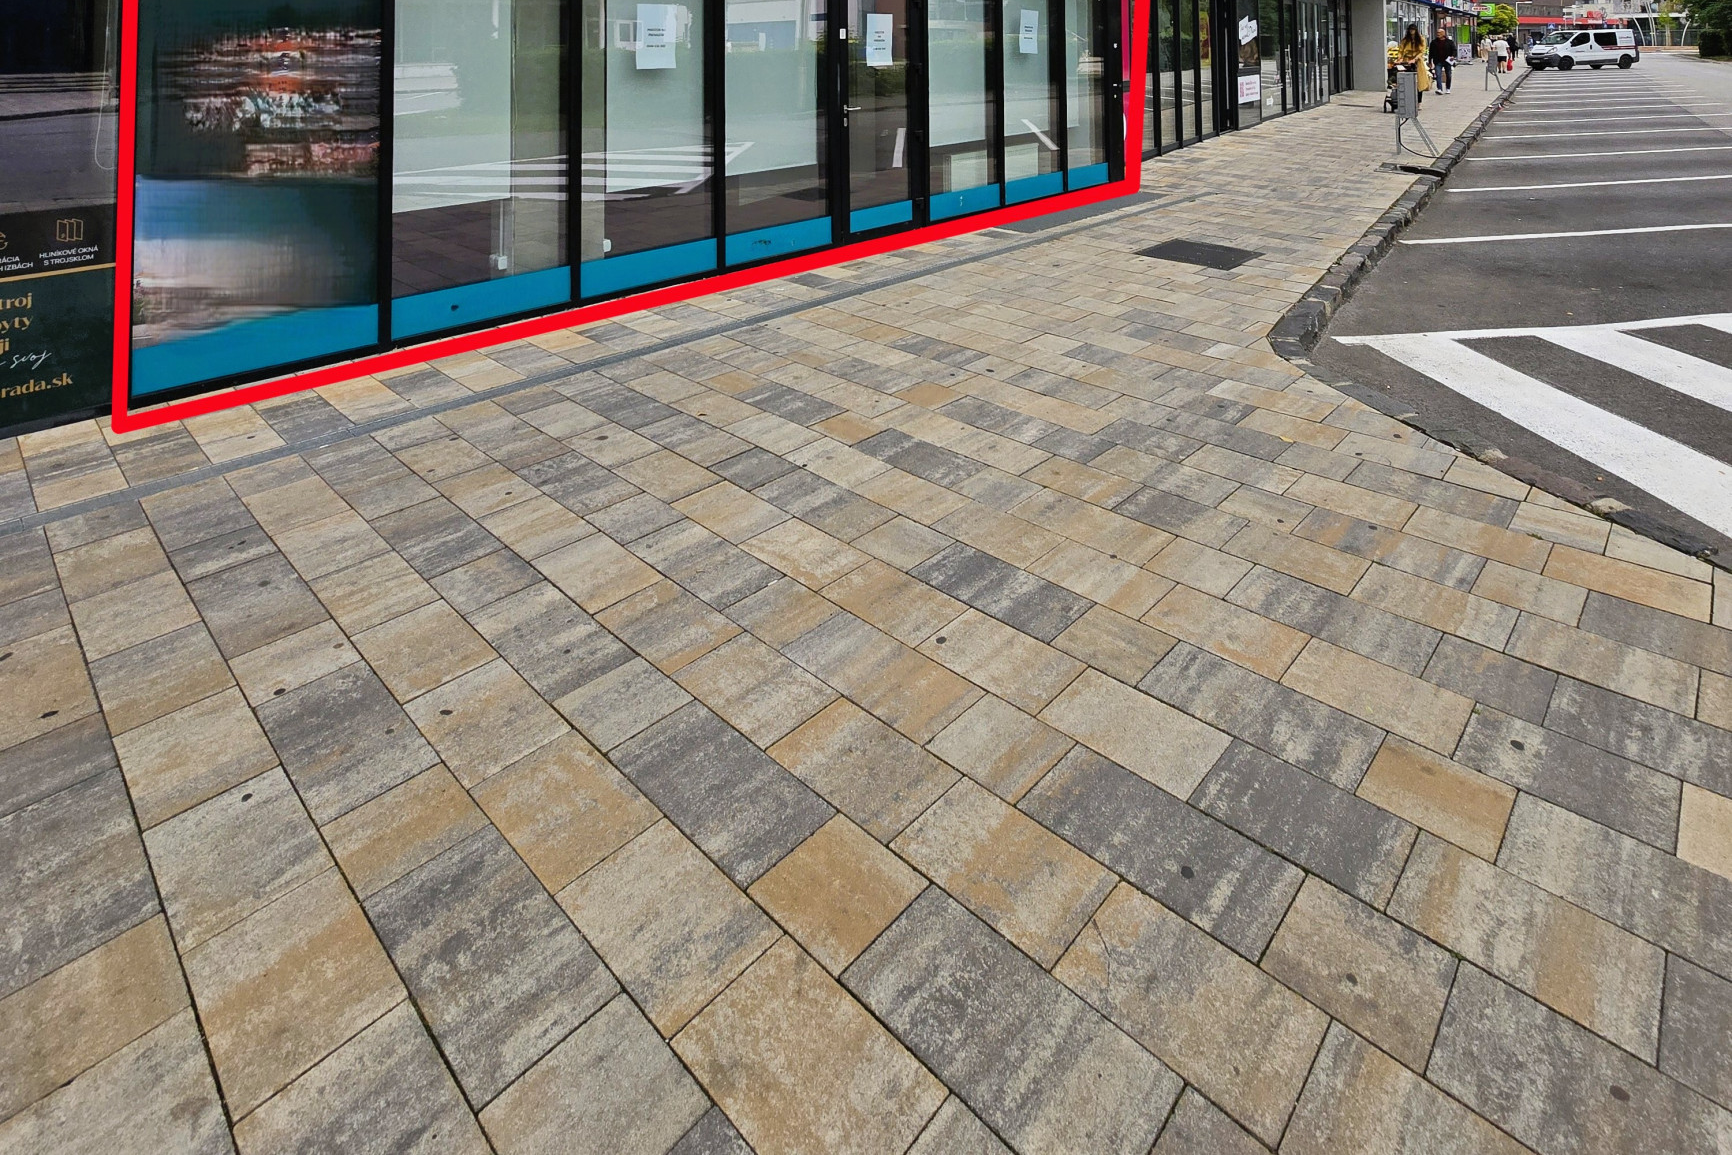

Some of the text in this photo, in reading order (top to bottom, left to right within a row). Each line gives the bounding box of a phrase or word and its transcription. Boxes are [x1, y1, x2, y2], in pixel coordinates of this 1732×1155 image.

[39, 244, 99, 259] HLINÍKOVÉ OKNÁ
[50, 254, 94, 265] TROJSKLOM
[4, 262, 34, 271] IZBÁCH
[0, 315, 34, 334] yty
[10, 349, 52, 370] svoj
[1, 372, 73, 399] rada.sk
